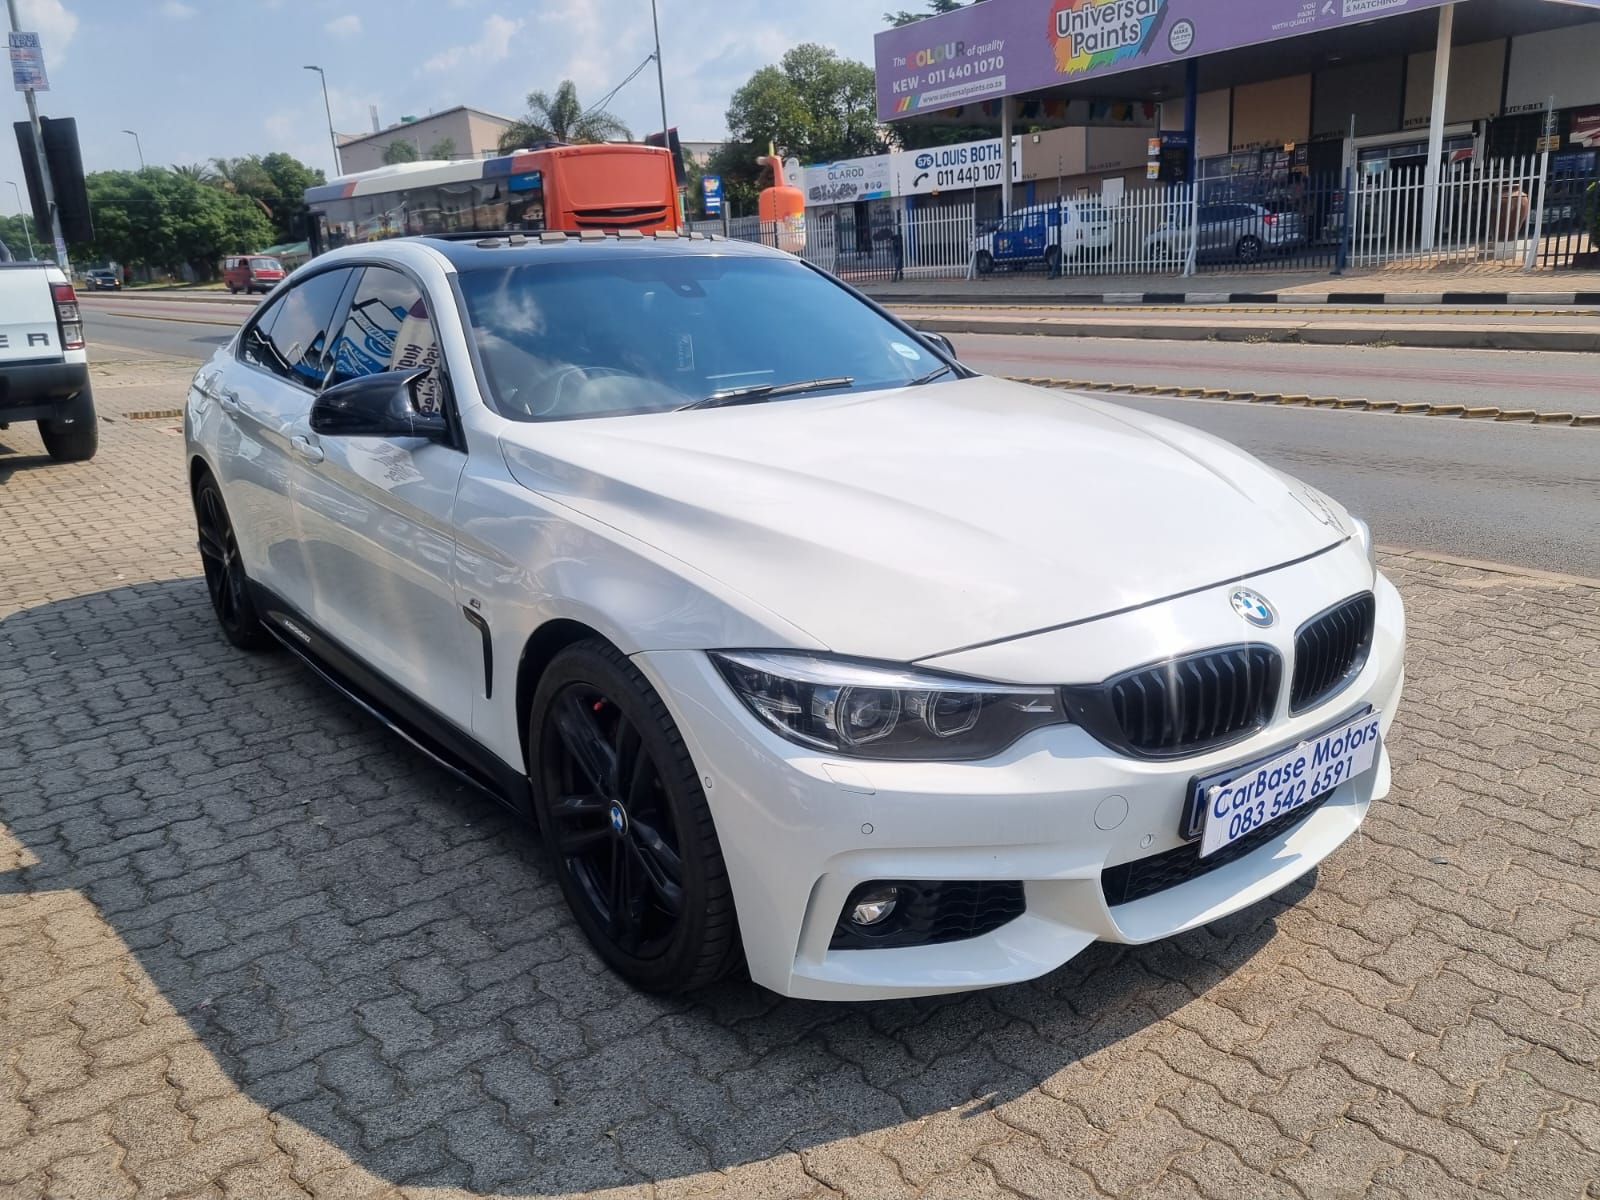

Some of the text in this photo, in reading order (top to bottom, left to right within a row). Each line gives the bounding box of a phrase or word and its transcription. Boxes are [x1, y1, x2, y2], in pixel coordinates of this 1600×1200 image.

[1057, 0, 1156, 35] Universal
[1289, 16, 1315, 27] QUALITY
[1302, 2, 1316, 10] YOU
[893, 40, 1005, 70] The COLOUR of quality
[1073, 22, 1139, 56] Paints
[892, 76, 919, 94] KEW
[928, 70, 946, 85] 011
[949, 63, 971, 80] 440
[974, 56, 1004, 74] 1070
[935, 148, 967, 167] LOUIS
[971, 143, 1001, 163] BOTH
[937, 169, 953, 186] 011
[957, 166, 980, 183] 440
[1213, 756, 1306, 819] CarBase
[1311, 721, 1378, 770] Motors
[1228, 801, 1265, 840] 083
[1270, 780, 1306, 817] 542
[1311, 756, 1353, 796] 6591
